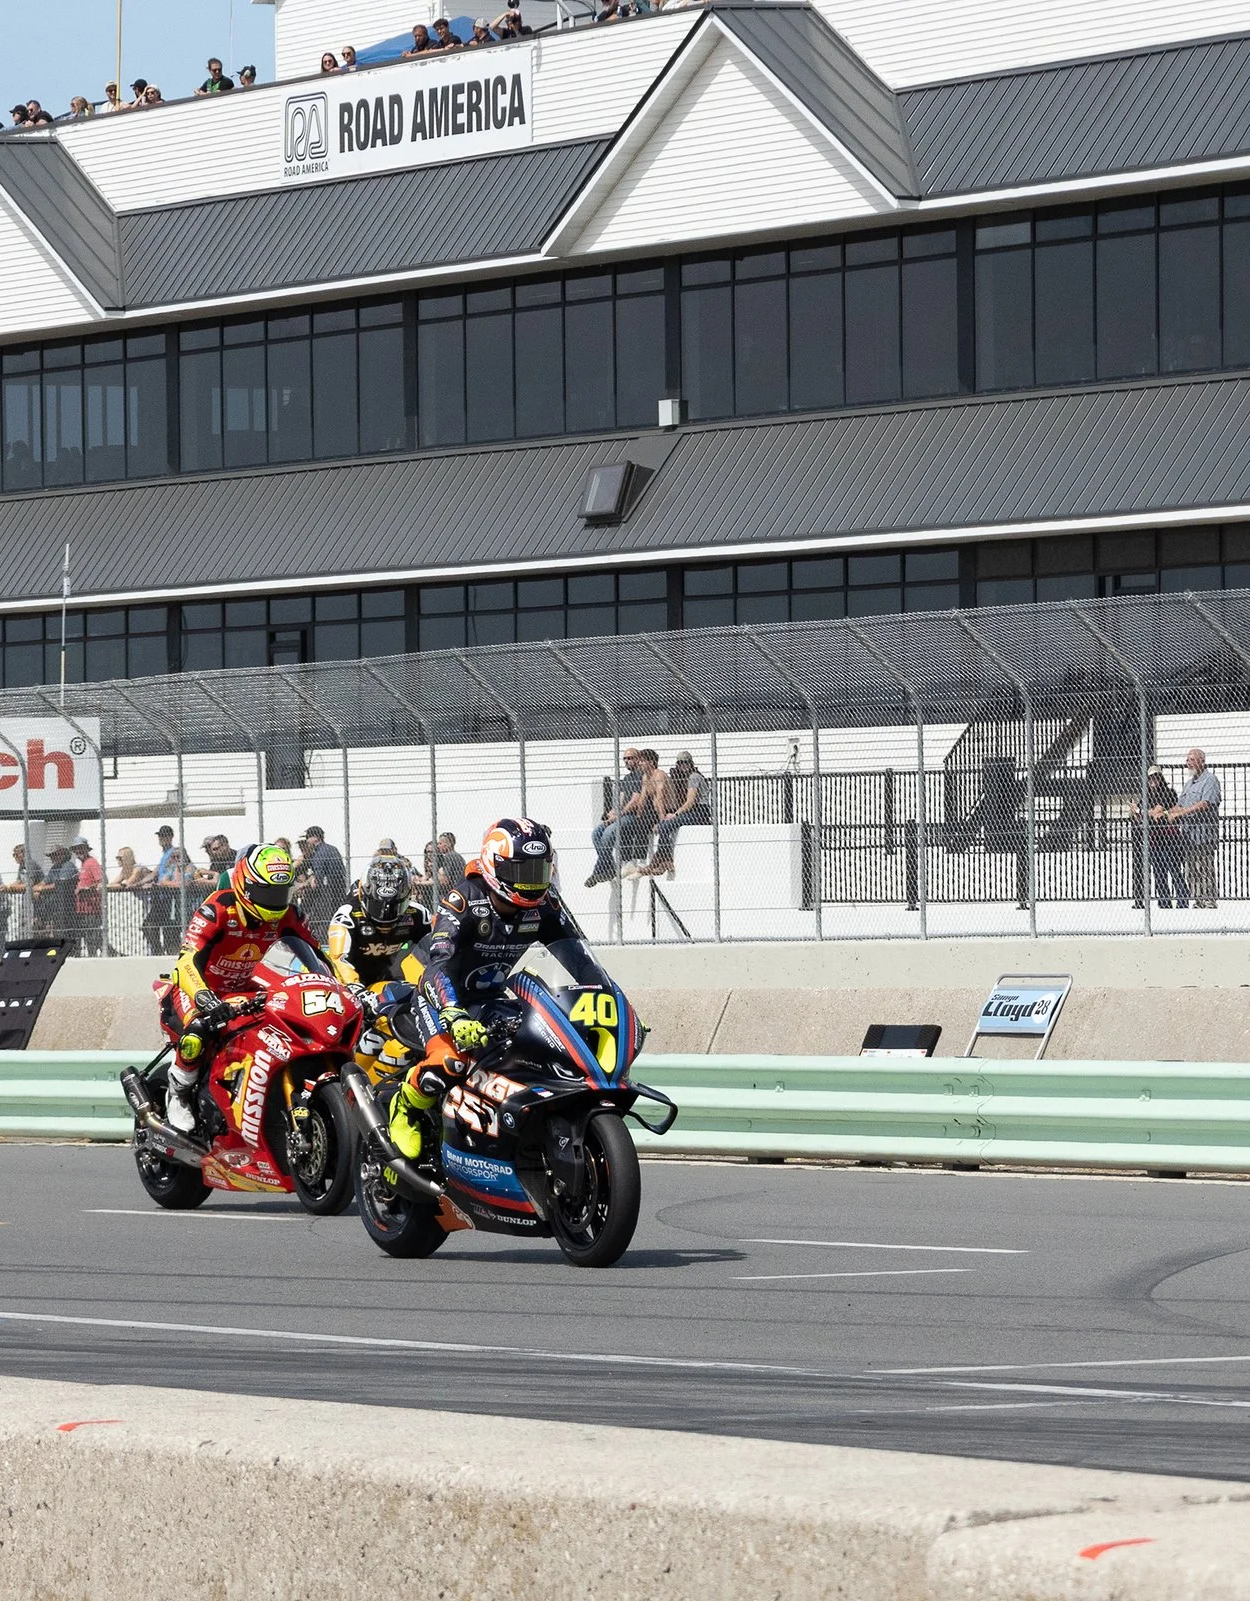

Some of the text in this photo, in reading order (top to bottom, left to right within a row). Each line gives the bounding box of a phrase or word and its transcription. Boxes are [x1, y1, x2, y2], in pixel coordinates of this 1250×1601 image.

[339, 73, 526, 153] ROAD AMERICA
[284, 161, 329, 178] ROAD AMERICA
[524, 842, 544, 851] Arai
[274, 874, 289, 882] Arai
[209, 965, 252, 979] SUZU
[302, 991, 344, 1016] 54
[570, 993, 619, 1027] 40
[982, 1001, 1038, 1021] Lloyd
[1034, 1000, 1051, 1015] 28
[258, 1030, 291, 1058] SUZUKI
[241, 1049, 271, 1147] mission
[447, 1150, 513, 1176] BMW MOTORRAD
[246, 1172, 281, 1186] DUNLOP
[497, 1214, 537, 1227] DUNLOP
